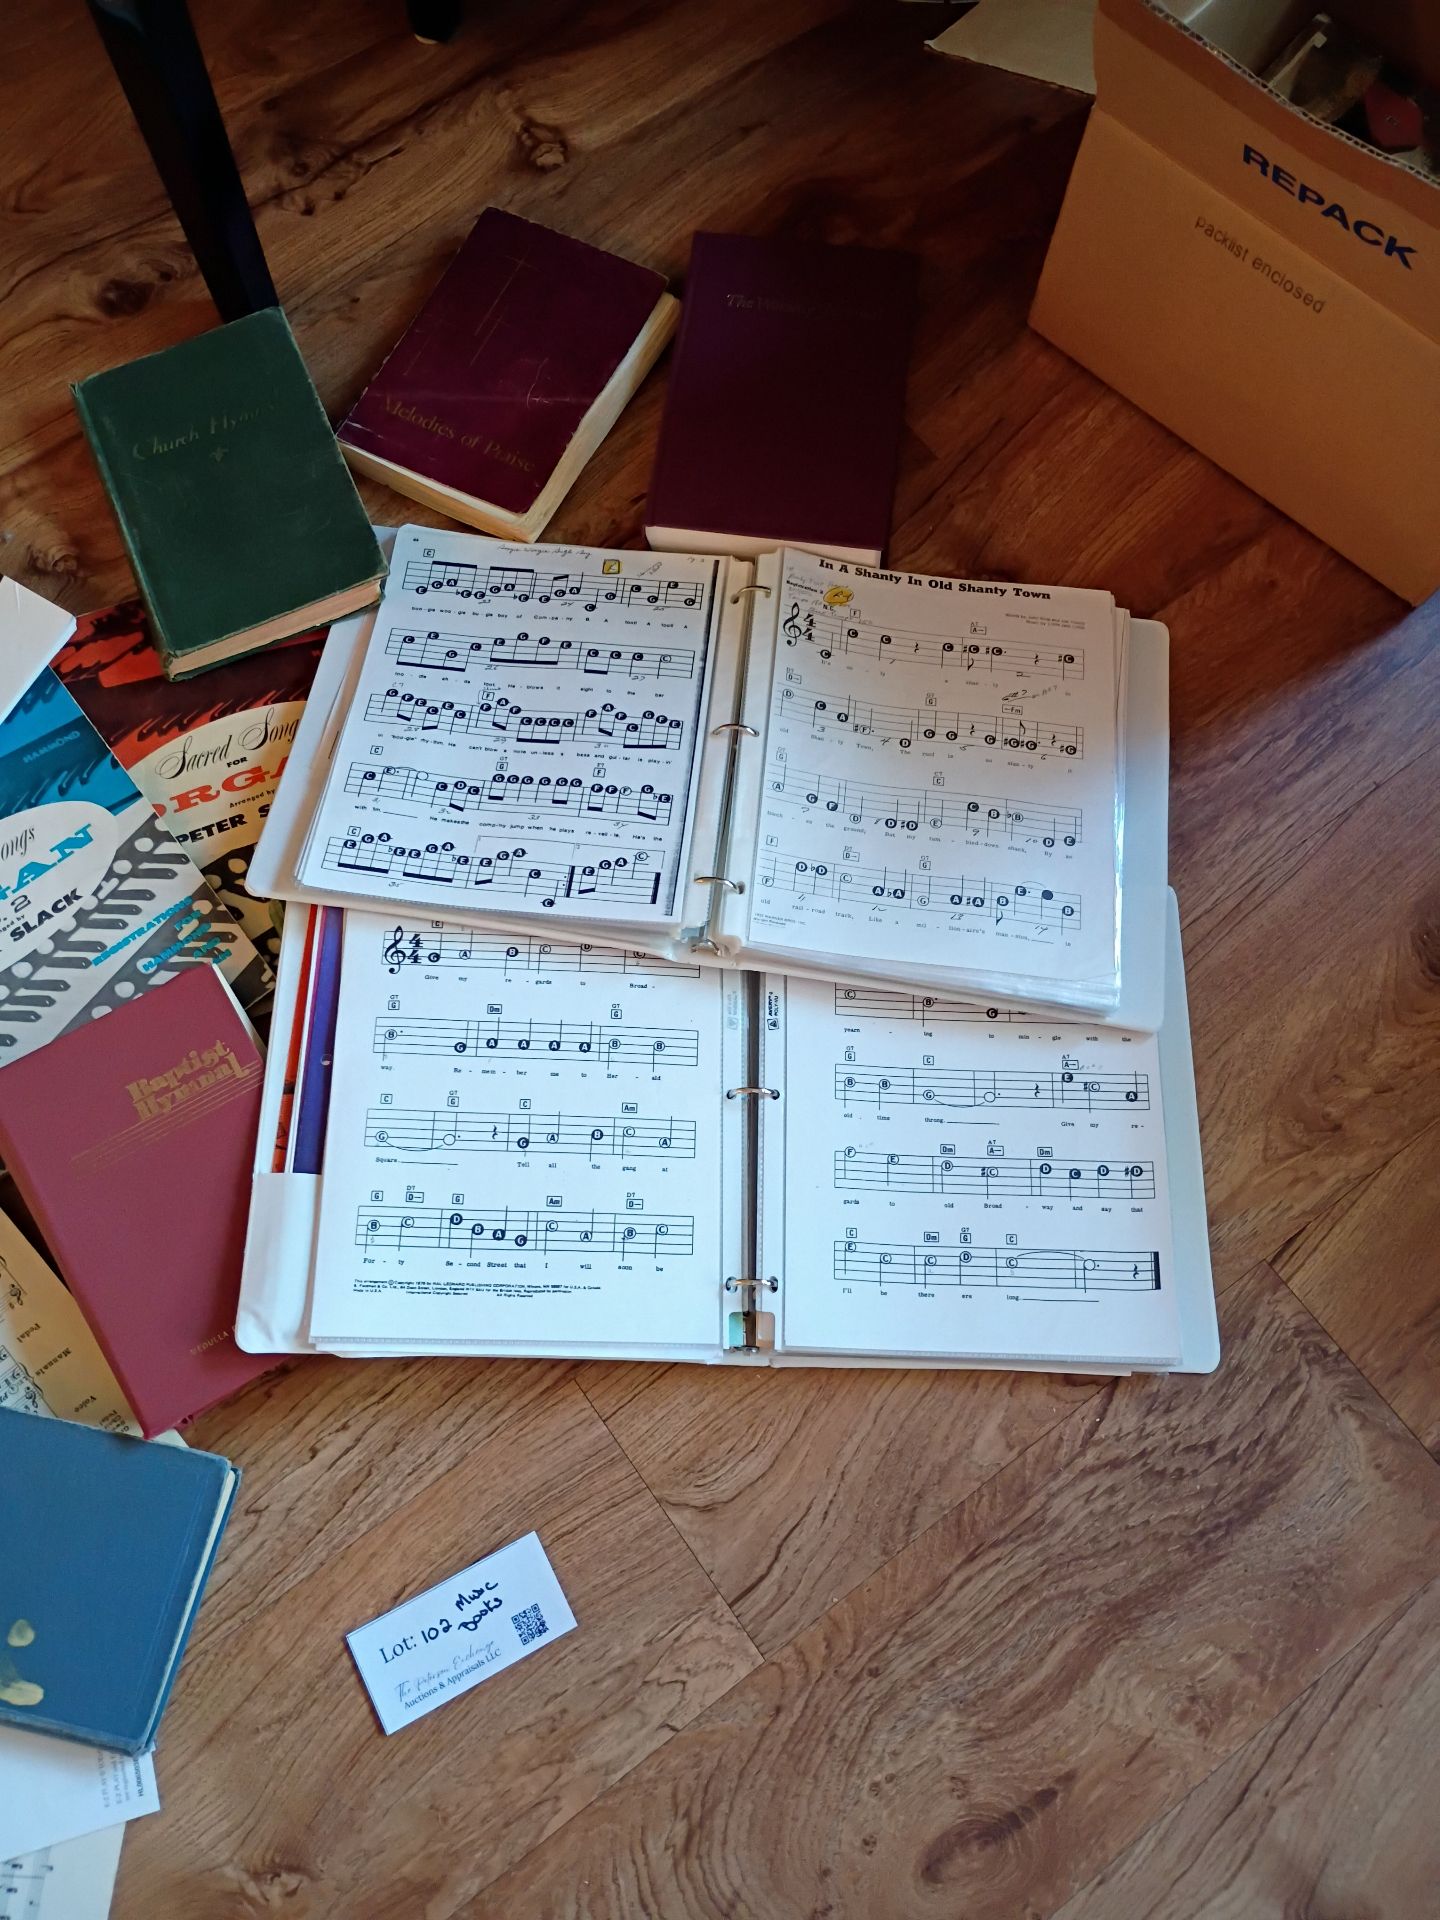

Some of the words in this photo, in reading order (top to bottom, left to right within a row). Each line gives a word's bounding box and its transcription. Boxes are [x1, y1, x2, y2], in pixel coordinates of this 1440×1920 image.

[1243, 143, 1418, 270] REPACK
[1195, 215, 1249, 262] packlist
[1252, 257, 1326, 313] enclosed
[133, 425, 199, 460] Church
[384, 395, 455, 439] Melodies
[461, 432, 483, 448] of
[484, 440, 535, 472] Praise
[819, 559, 833, 570] In
[839, 565, 849, 573] A
[855, 567, 901, 584] Shanty
[908, 576, 922, 586] In
[929, 580, 952, 590] Old
[959, 583, 1007, 596] Shanty
[1013, 588, 1051, 599] Town
[23, 731, 80, 763] HAMMOND
[155, 735, 232, 779] Sacred
[238, 707, 300, 750] Song
[227, 757, 248, 768] FOR
[229, 793, 264, 808] Arranged
[1, 828, 34, 861] ongs
[176, 814, 248, 843] PETER
[10, 888, 83, 942] SLACK
[11, 895, 31, 913] 2
[92, 895, 192, 966] REGISTRATIONS
[175, 910, 201, 931] FOR
[143, 922, 211, 972] HAMMOND
[194, 937, 221, 959] AND
[125, 1040, 229, 1102] Baptist
[132, 1052, 251, 1120] Hymnal
[17, 1323, 41, 1343] Pedal
[35, 1348, 72, 1376] Manuals
[74, 1395, 96, 1412] Voice
[421, 1619, 452, 1643] 102
[379, 1636, 417, 1664] Lot:
[394, 1681, 411, 1702] The
[404, 1684, 438, 1709] Auctions
[447, 1660, 485, 1686] Appraisals
[485, 1648, 501, 1662] LLC
